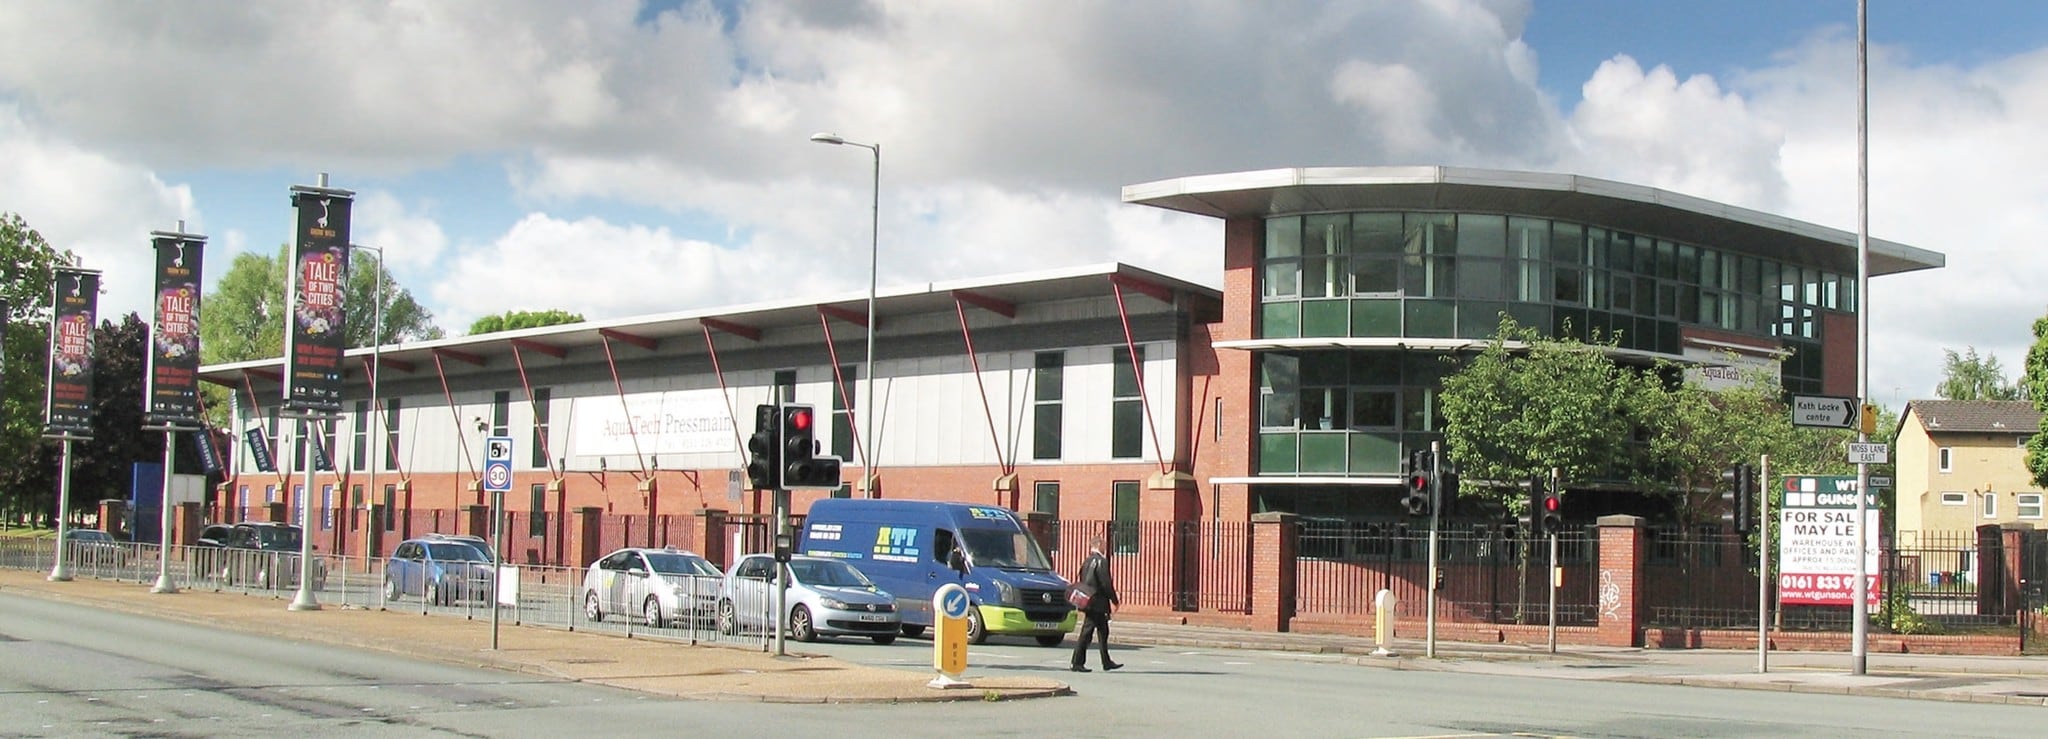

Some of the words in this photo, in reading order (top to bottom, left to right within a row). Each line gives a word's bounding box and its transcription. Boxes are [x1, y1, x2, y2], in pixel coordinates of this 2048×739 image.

[308, 261, 336, 281] TALE
[308, 281, 318, 292] OF
[319, 282, 334, 293] TWO
[166, 295, 190, 312] TALE
[308, 292, 334, 306] CITIES
[166, 312, 175, 322] OF
[64, 321, 86, 337] TALE
[166, 322, 189, 334] CITIES
[64, 344, 85, 355] CITIES
[1798, 402, 1815, 410] Kath
[1818, 403, 1840, 412] Locke
[1806, 413, 1830, 422] centre
[604, 413, 660, 441] AquaTech
[665, 411, 733, 434] Pressmain
[1851, 445, 1868, 454] MOSS
[1870, 445, 1886, 454] LANE
[1861, 453, 1876, 462] EAST
[491, 471, 506, 481] 30
[1835, 480, 1858, 491] WT
[1817, 493, 1875, 506] GUNSN
[1785, 512, 1817, 523] FOR
[1825, 512, 1856, 523] SAL
[1795, 525, 1828, 536] MAY
[1835, 526, 1855, 536] LE
[1792, 539, 1842, 547] WAREHOUSE
[1783, 548, 1816, 556] OFFICES
[1820, 548, 1837, 556] AND
[1840, 548, 1876, 557] PARNG
[1781, 575, 1812, 589] 0161
[1816, 576, 1840, 590] 833
[1843, 576, 1876, 590] 97
[1781, 591, 1876, 601] www.wtgunson.ck
